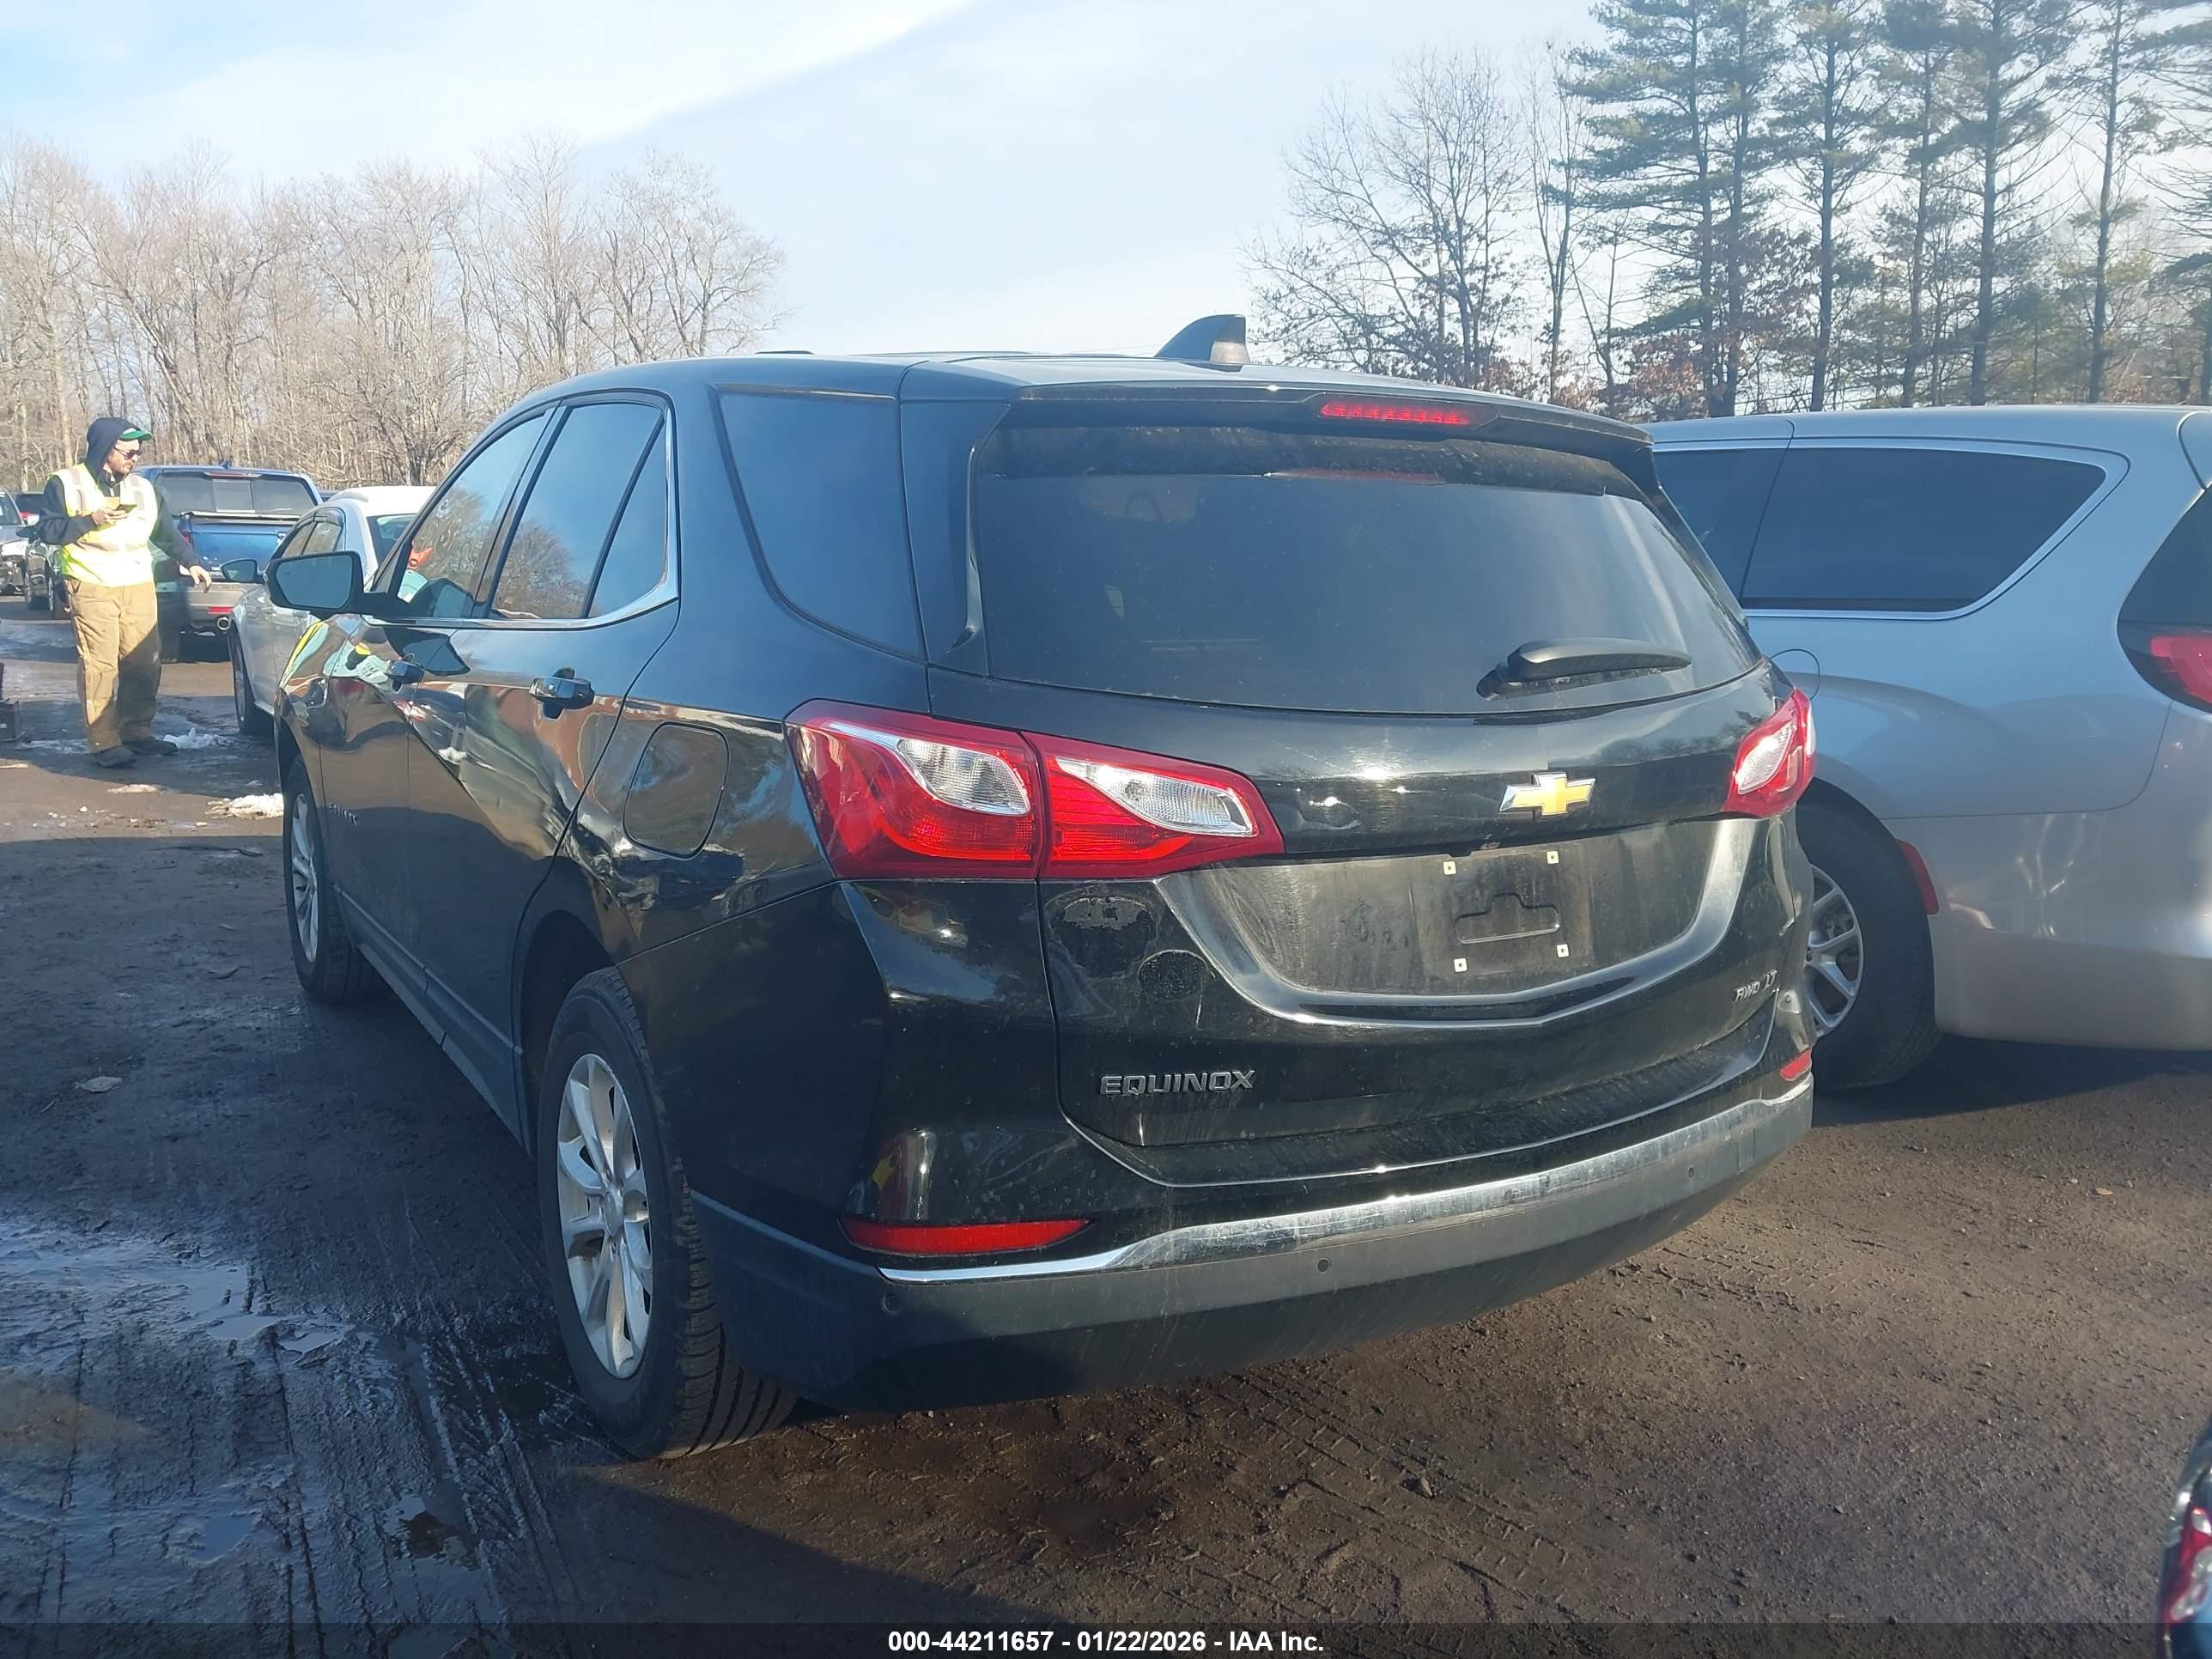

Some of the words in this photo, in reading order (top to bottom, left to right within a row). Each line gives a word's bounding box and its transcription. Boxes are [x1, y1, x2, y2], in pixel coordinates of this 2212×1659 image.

[1735, 981, 1760, 1002] AWD
[1763, 969, 1778, 991] LT
[1100, 1070, 1255, 1095] EQUINOX
